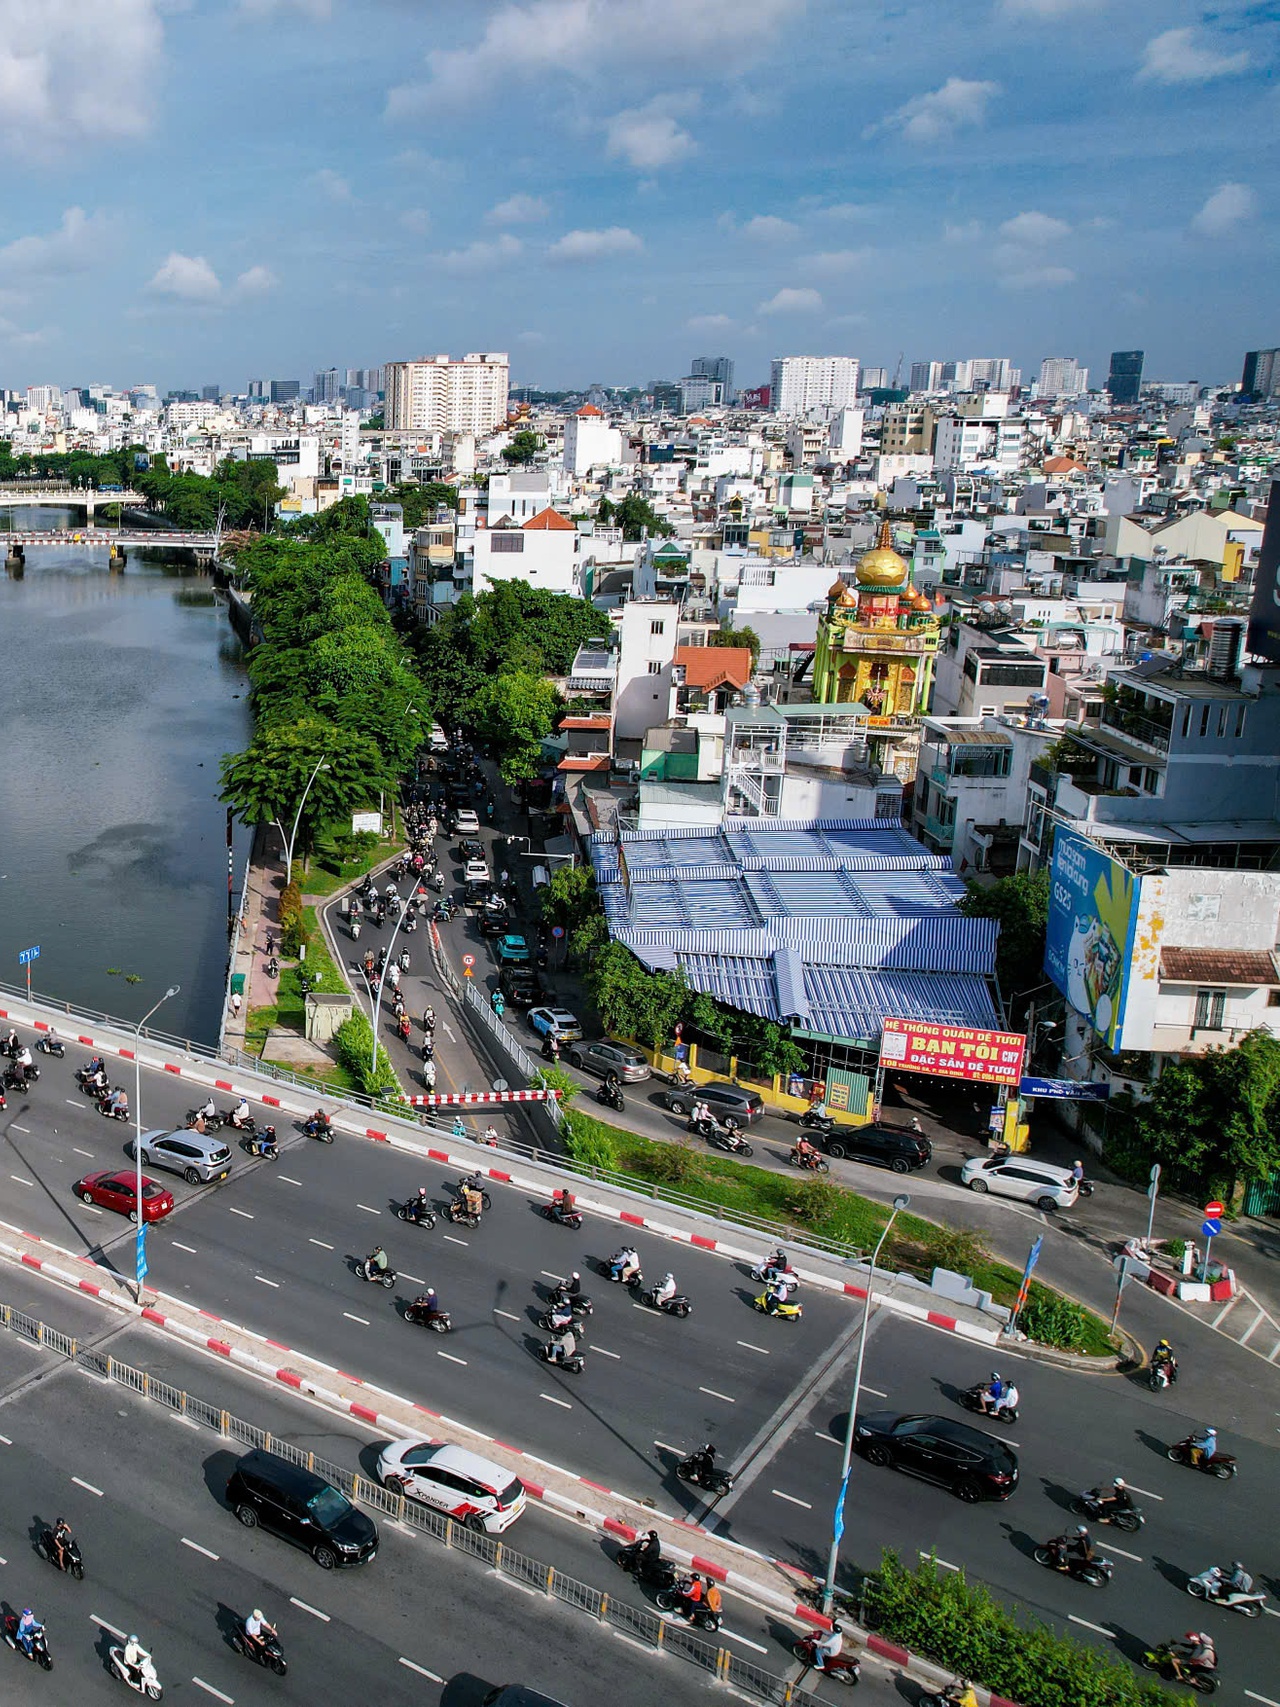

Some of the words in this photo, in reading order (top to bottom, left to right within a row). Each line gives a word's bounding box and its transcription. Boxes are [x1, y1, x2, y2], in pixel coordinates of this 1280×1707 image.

[1054, 882, 1071, 910] GS25
[886, 1021, 899, 1031] HỆ
[903, 1023, 939, 1035] THỐNG
[943, 1028, 973, 1039] QUÁN
[996, 1035, 1021, 1045] TƯƠI
[912, 1037, 956, 1055] BẠN
[961, 1043, 998, 1060] TÔI
[911, 1054, 935, 1065] ĐẶC
[939, 1058, 964, 1069] SẢN
[968, 1062, 983, 1072] DÊ
[988, 1065, 1016, 1075] TƯƠI
[414, 1488, 449, 1508] XPANDER
